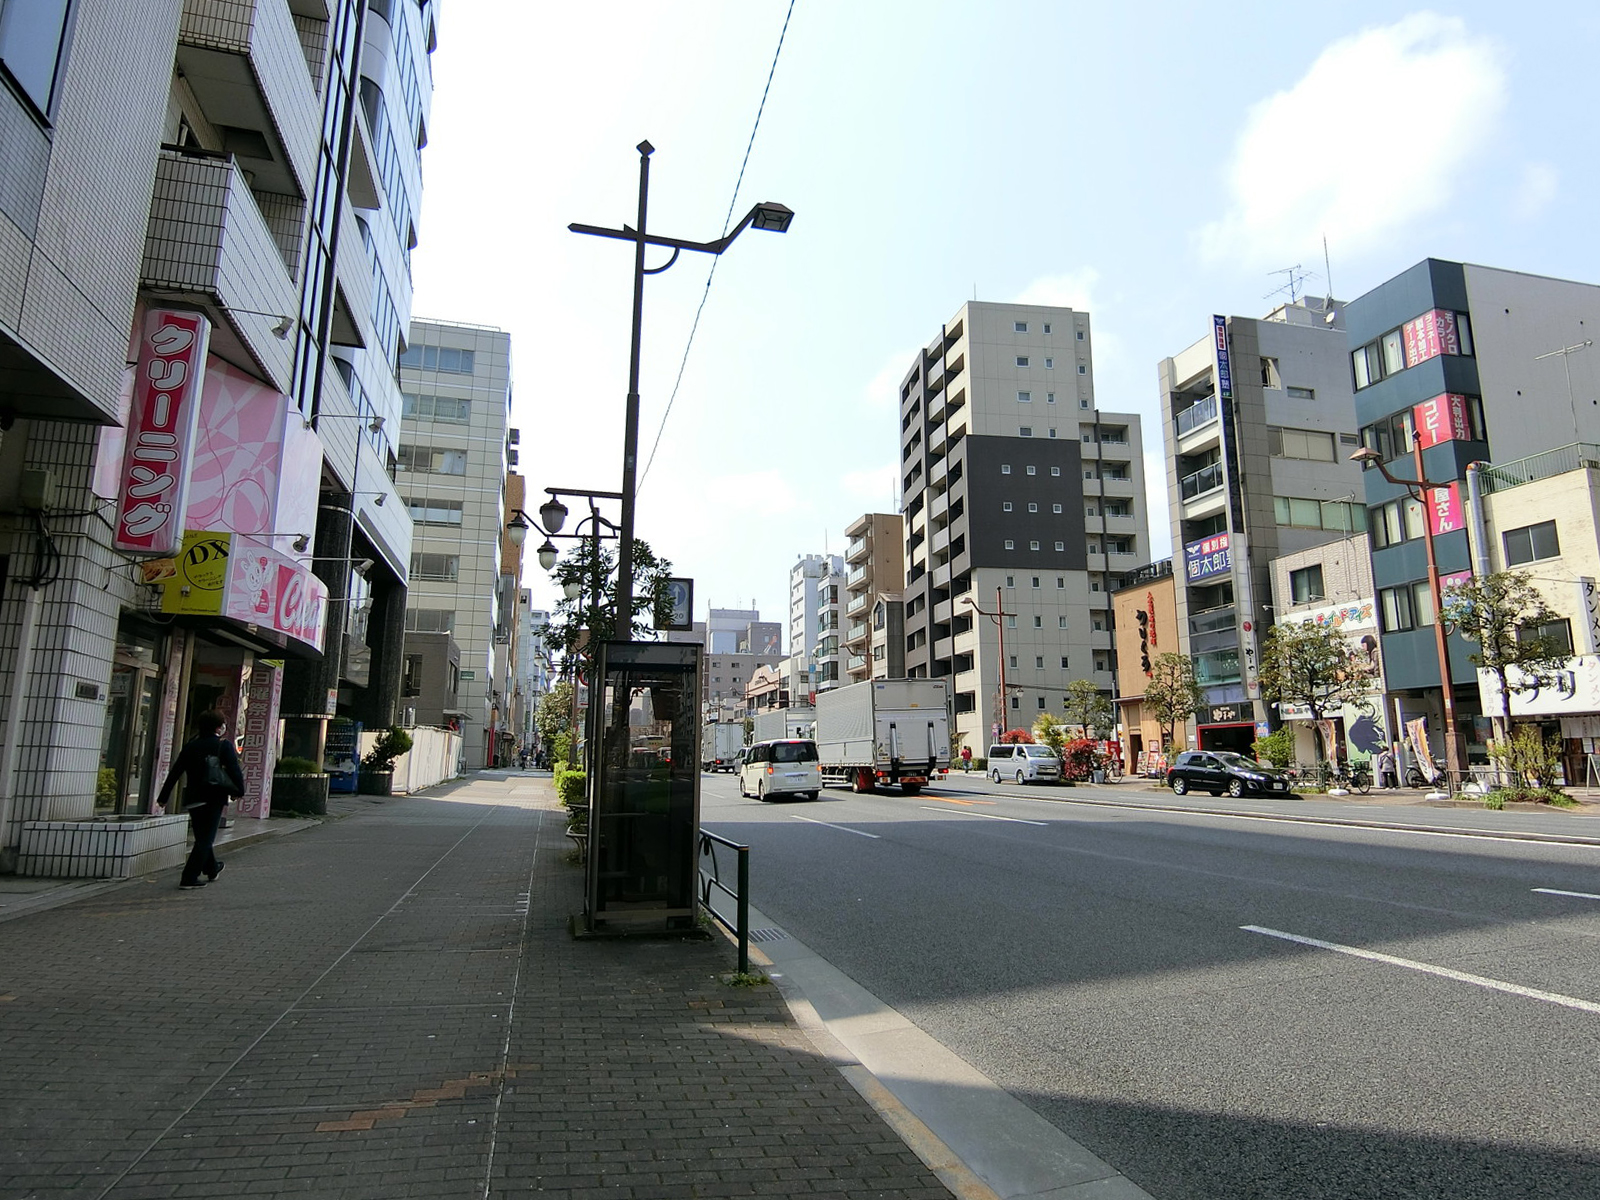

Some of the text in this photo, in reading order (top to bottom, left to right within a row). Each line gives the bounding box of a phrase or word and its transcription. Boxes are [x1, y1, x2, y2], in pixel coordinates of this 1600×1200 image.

[1406, 322, 1418, 366] データ出力
[1425, 313, 1437, 356] ラミネート
[1436, 317, 1446, 348] カラー
[1445, 312, 1457, 354] モノクロ
[122, 324, 195, 537] クリーニング
[1424, 400, 1439, 443] コピー
[1451, 395, 1465, 440] 大判出力
[1434, 487, 1453, 533] 屋さん
[190, 540, 229, 566] DX
[1585, 582, 1600, 648] タンメン
[239, 671, 271, 812] 日曜祭日即日仕上げ
